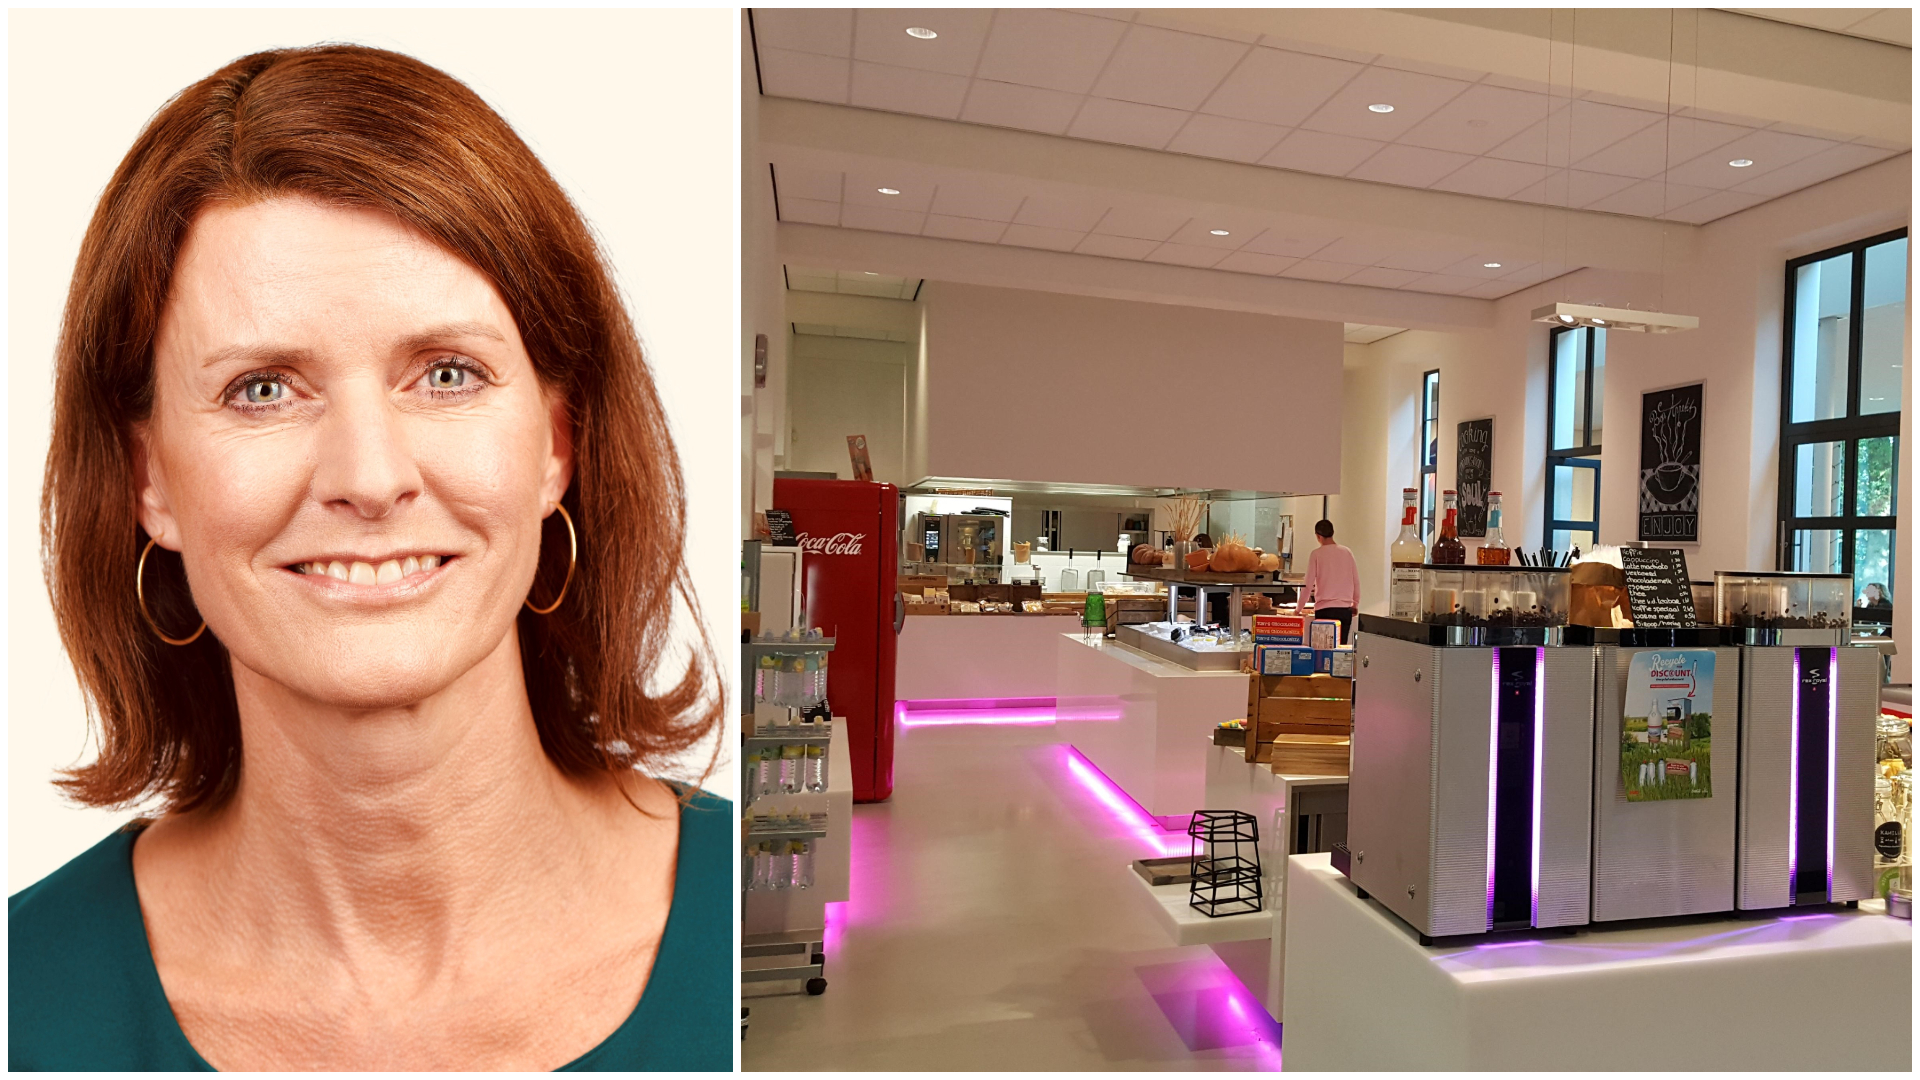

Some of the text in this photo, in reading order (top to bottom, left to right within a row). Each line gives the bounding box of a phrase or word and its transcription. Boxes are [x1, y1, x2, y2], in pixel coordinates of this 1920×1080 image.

[1643, 517, 1695, 535] ENJOY
[1649, 653, 1687, 671] Recycle
[1650, 669, 1691, 678] DISCOUNT
